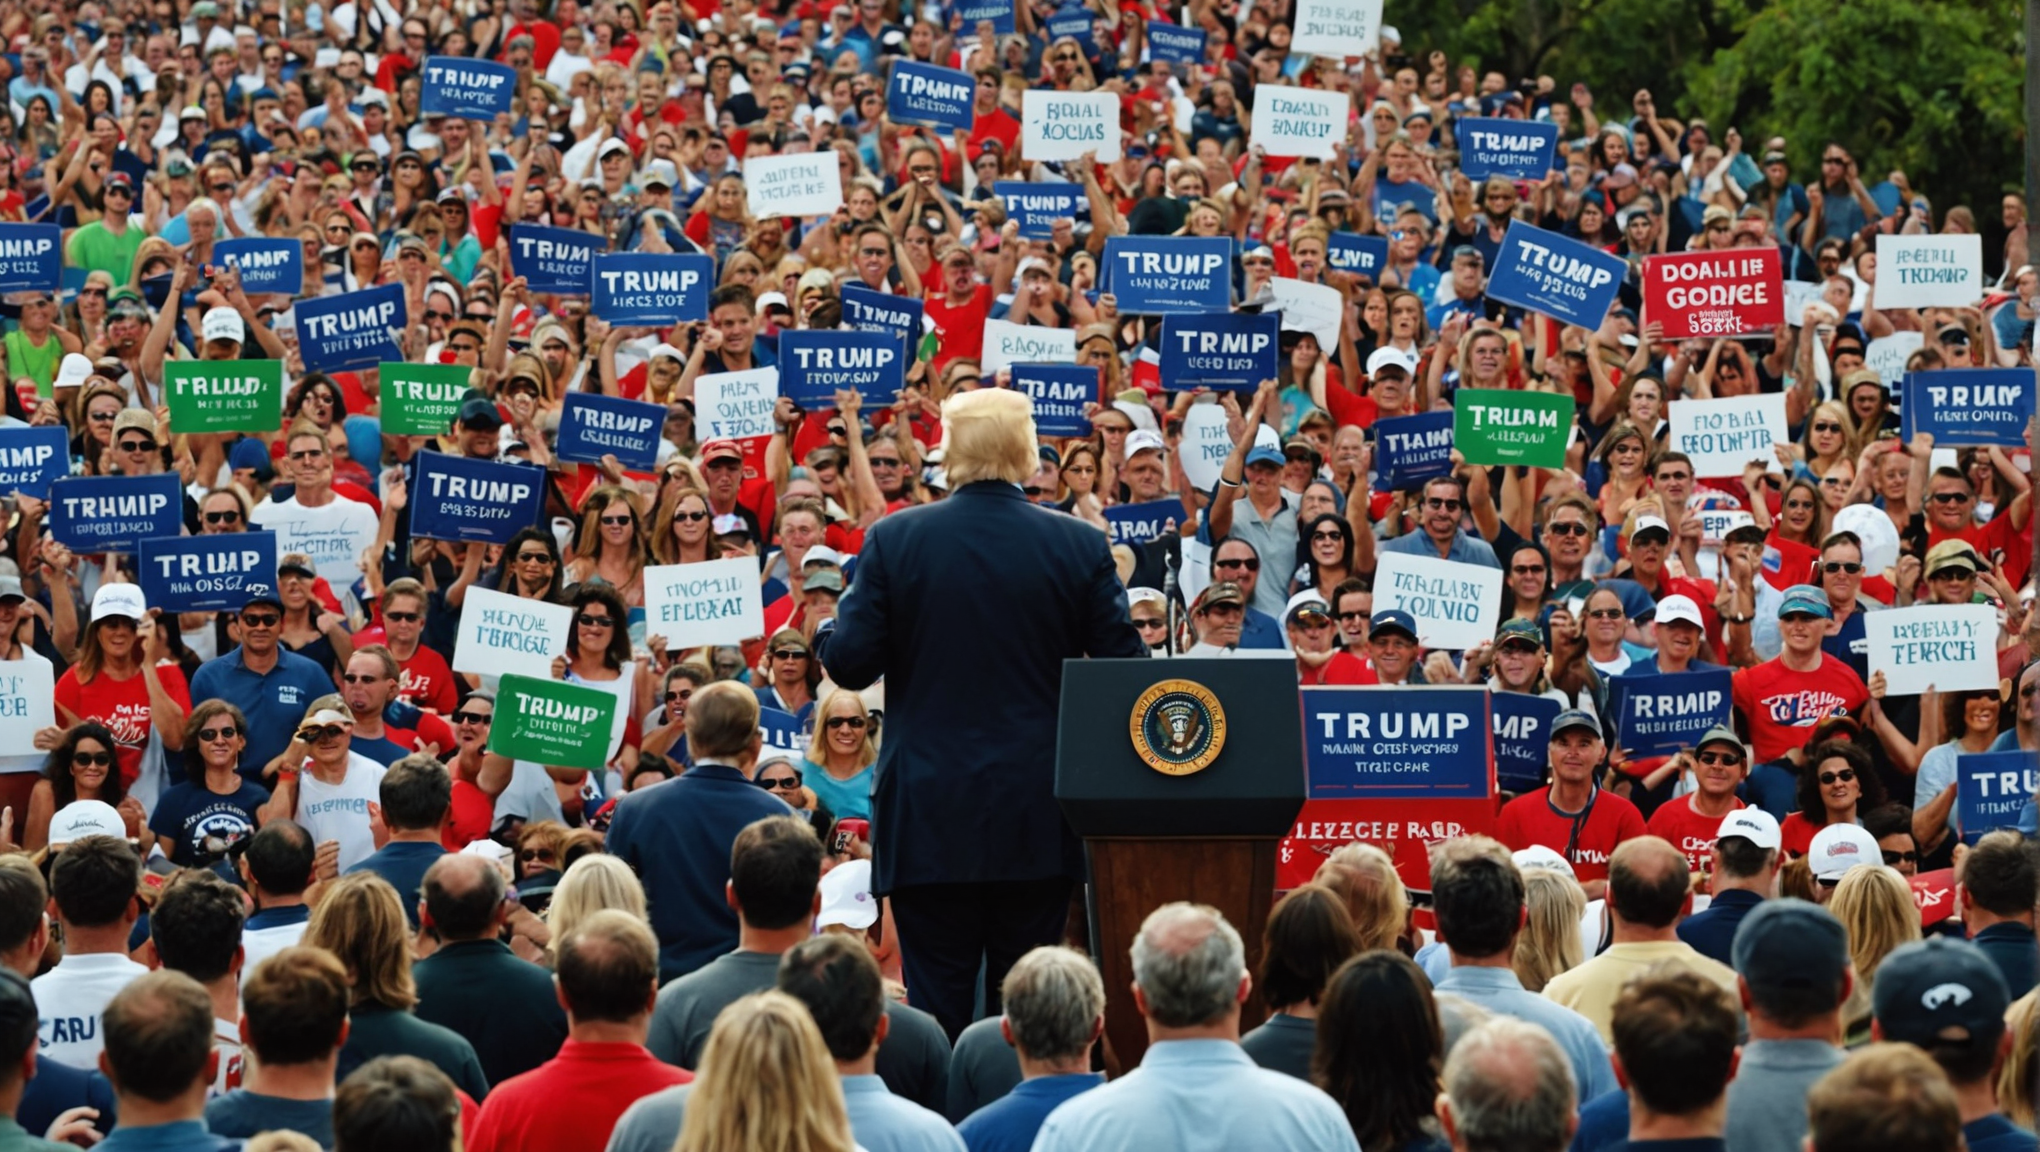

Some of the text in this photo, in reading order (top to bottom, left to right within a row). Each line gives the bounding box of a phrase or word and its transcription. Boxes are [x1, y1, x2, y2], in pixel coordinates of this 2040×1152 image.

[1119, 252, 1223, 275] TRUMP
[601, 271, 699, 294] TRUMP
[305, 302, 395, 340] TRUMP
[794, 348, 894, 368] TRUMP
[428, 472, 530, 504] TRUMP
[1316, 712, 1470, 739] TRUMP
